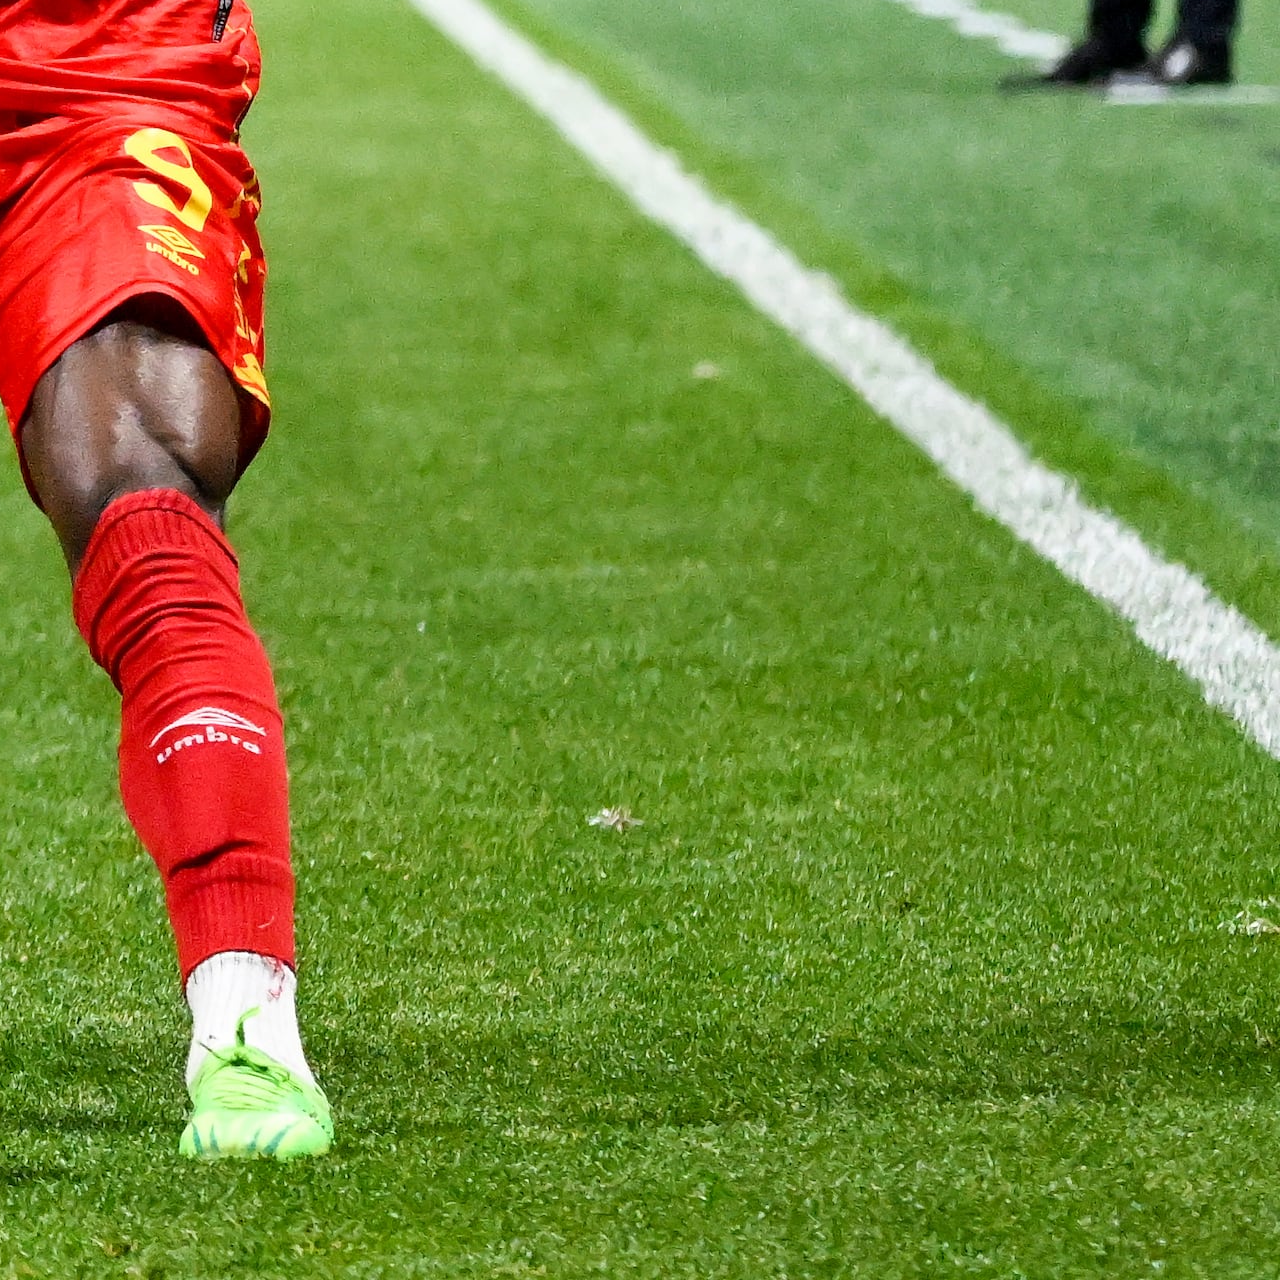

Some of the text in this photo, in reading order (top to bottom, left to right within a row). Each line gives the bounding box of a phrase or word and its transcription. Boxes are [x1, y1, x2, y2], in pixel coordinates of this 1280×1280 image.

[123, 127, 213, 233] 9
[145, 241, 200, 276] umbro
[156, 725, 262, 764] umbro
